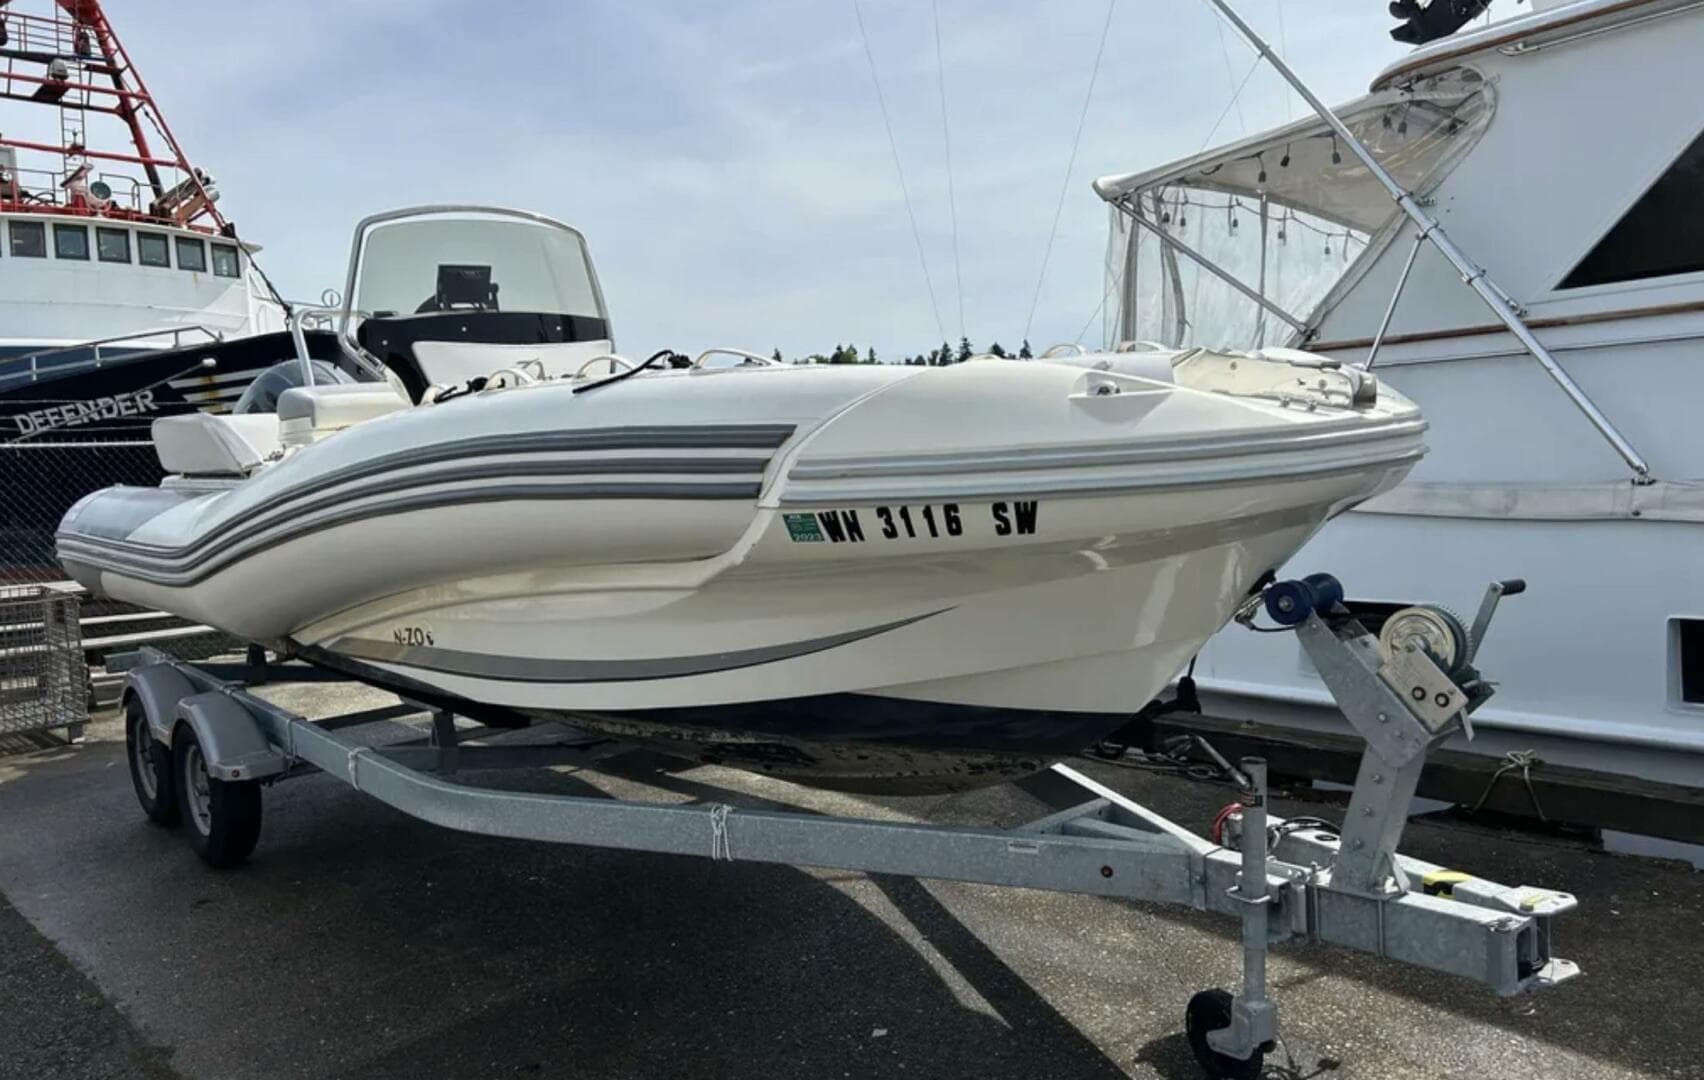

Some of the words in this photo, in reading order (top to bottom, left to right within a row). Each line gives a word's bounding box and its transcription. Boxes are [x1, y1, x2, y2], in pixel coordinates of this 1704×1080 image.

[14, 390, 159, 434] DEFENDER
[818, 510, 865, 542] WN
[876, 504, 963, 539] 3116
[992, 501, 1038, 536] SW
